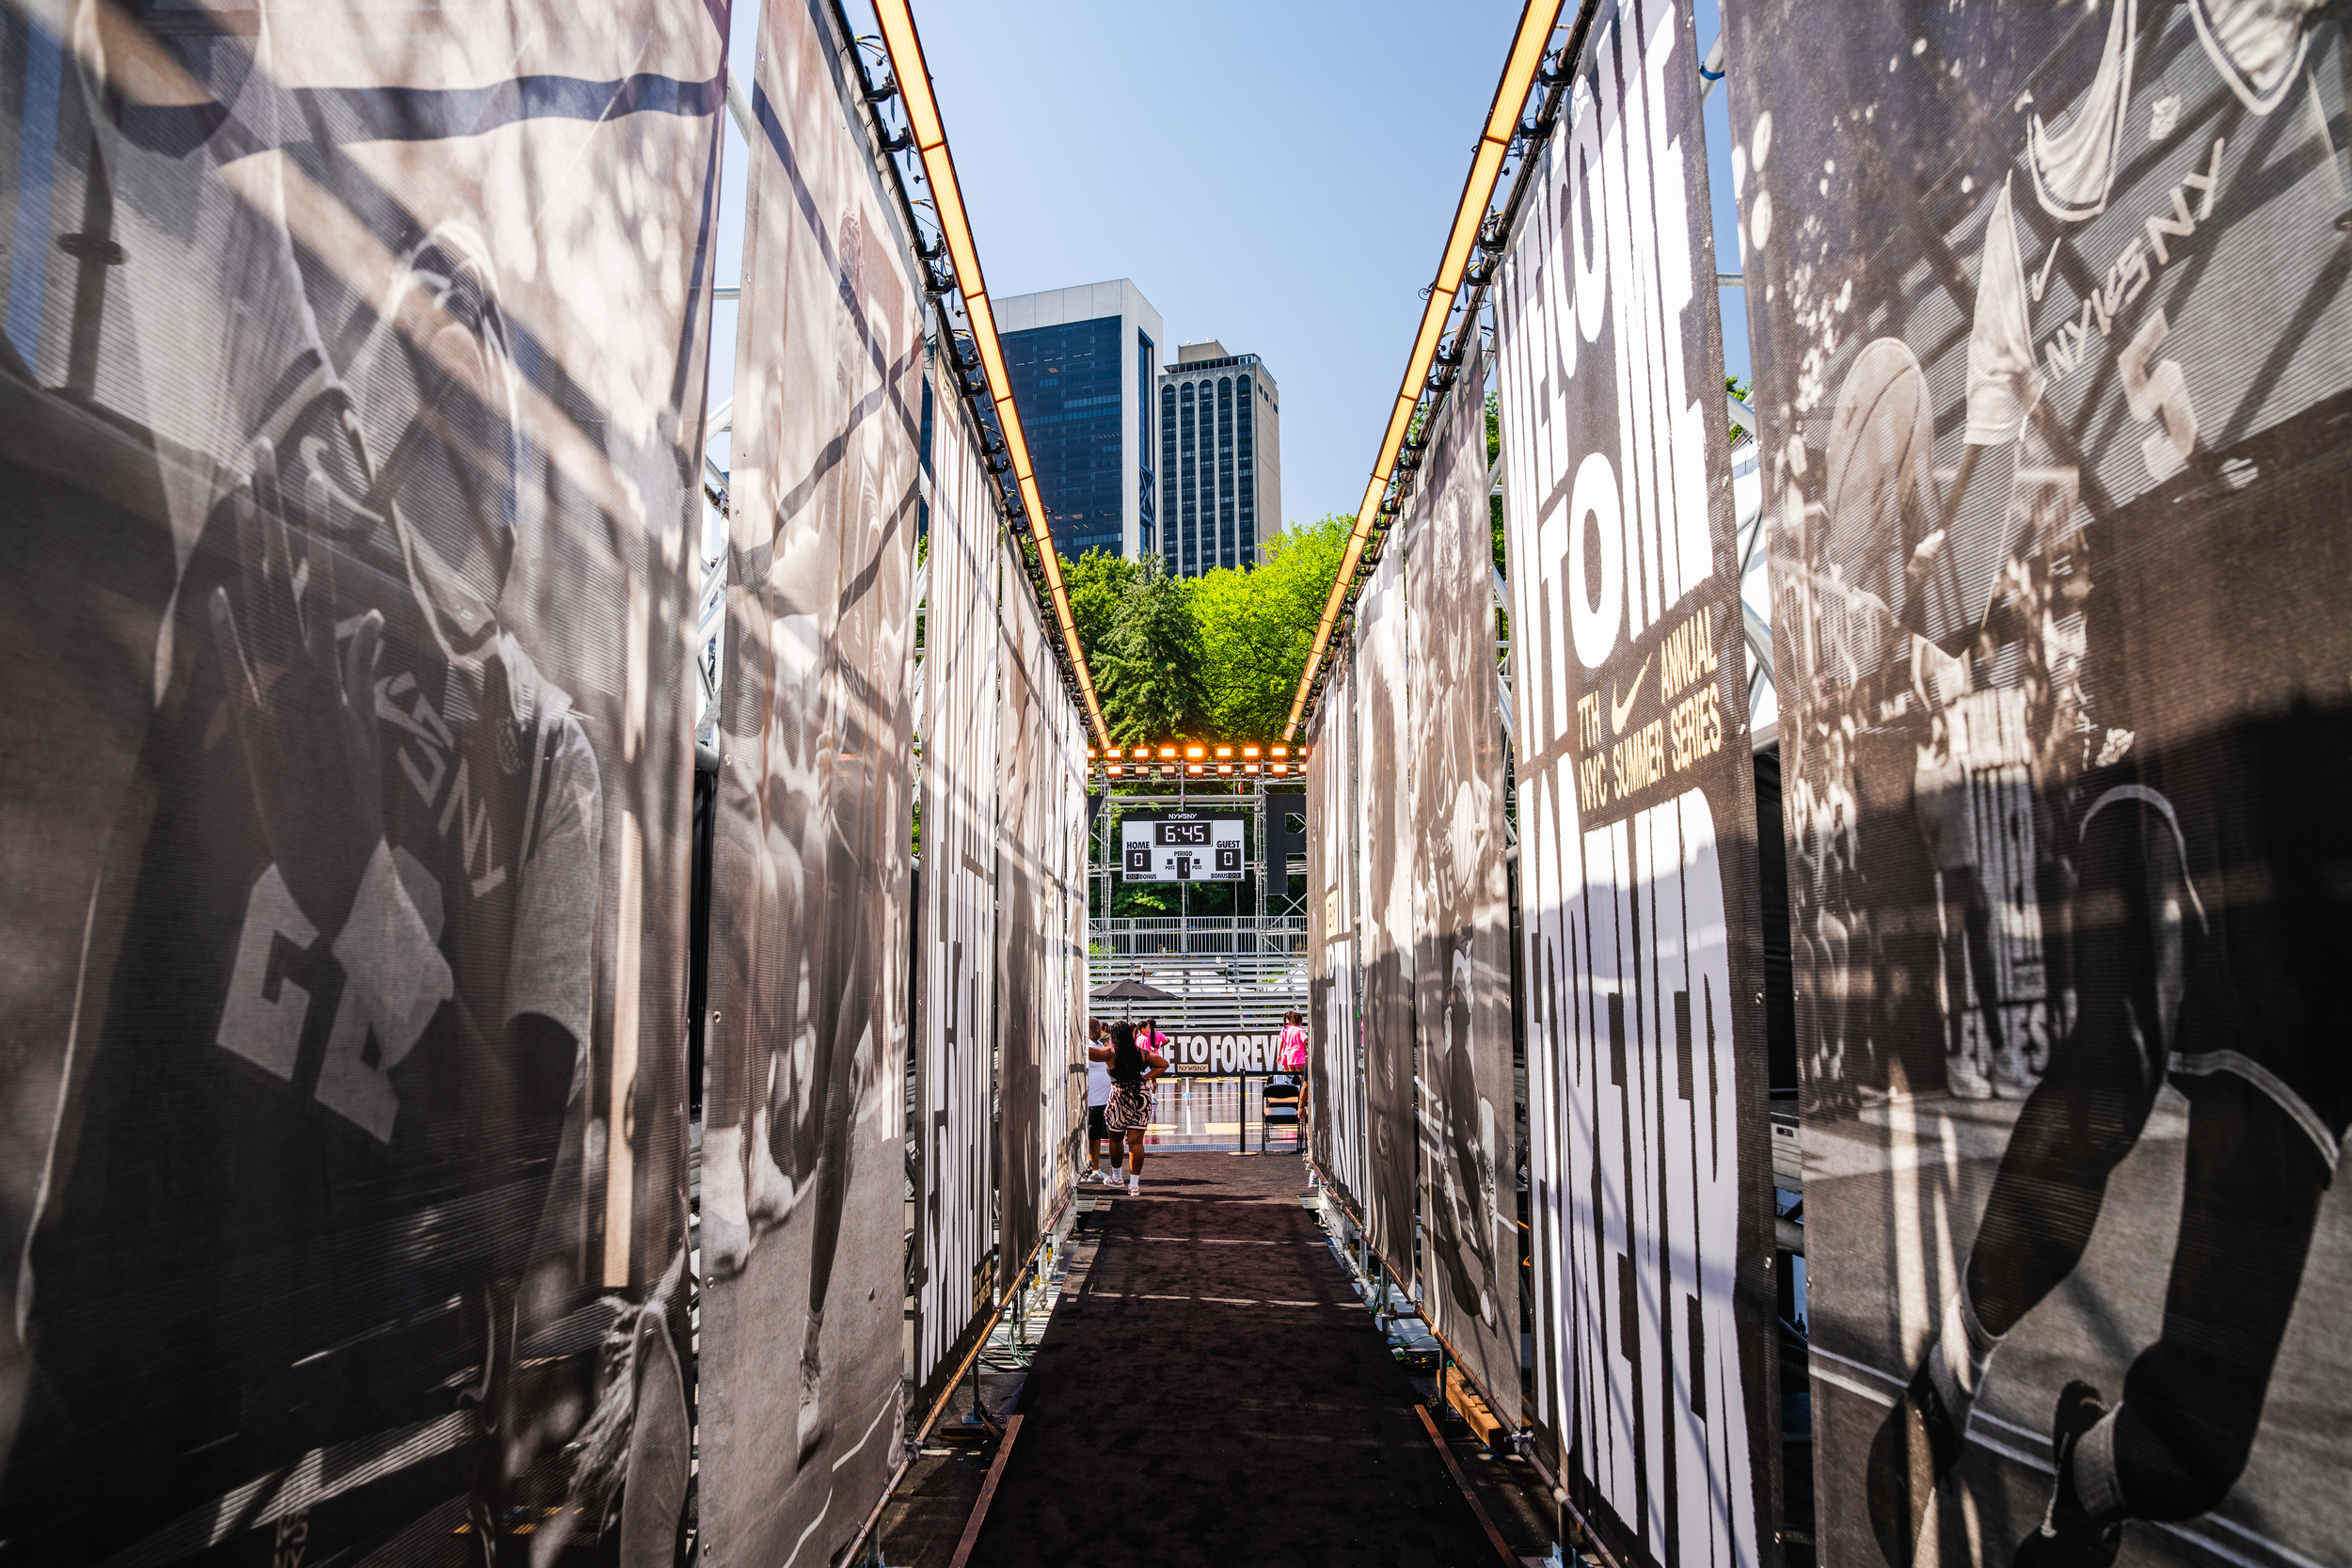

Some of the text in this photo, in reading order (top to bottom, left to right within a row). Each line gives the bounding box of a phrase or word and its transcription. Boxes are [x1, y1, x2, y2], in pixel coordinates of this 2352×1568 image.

[1540, 452, 1623, 740] TO
[1578, 606, 1718, 752] 7TH ANNUAL
[1580, 682, 1722, 813] NYC SUMMER SERIES
[1165, 825, 1204, 843] 6:45
[1126, 841, 1150, 849] HOME
[1216, 840, 1240, 848] GUEST
[1134, 852, 1143, 867] 0
[1223, 851, 1233, 866] 0
[1177, 1035, 1209, 1064] TO
